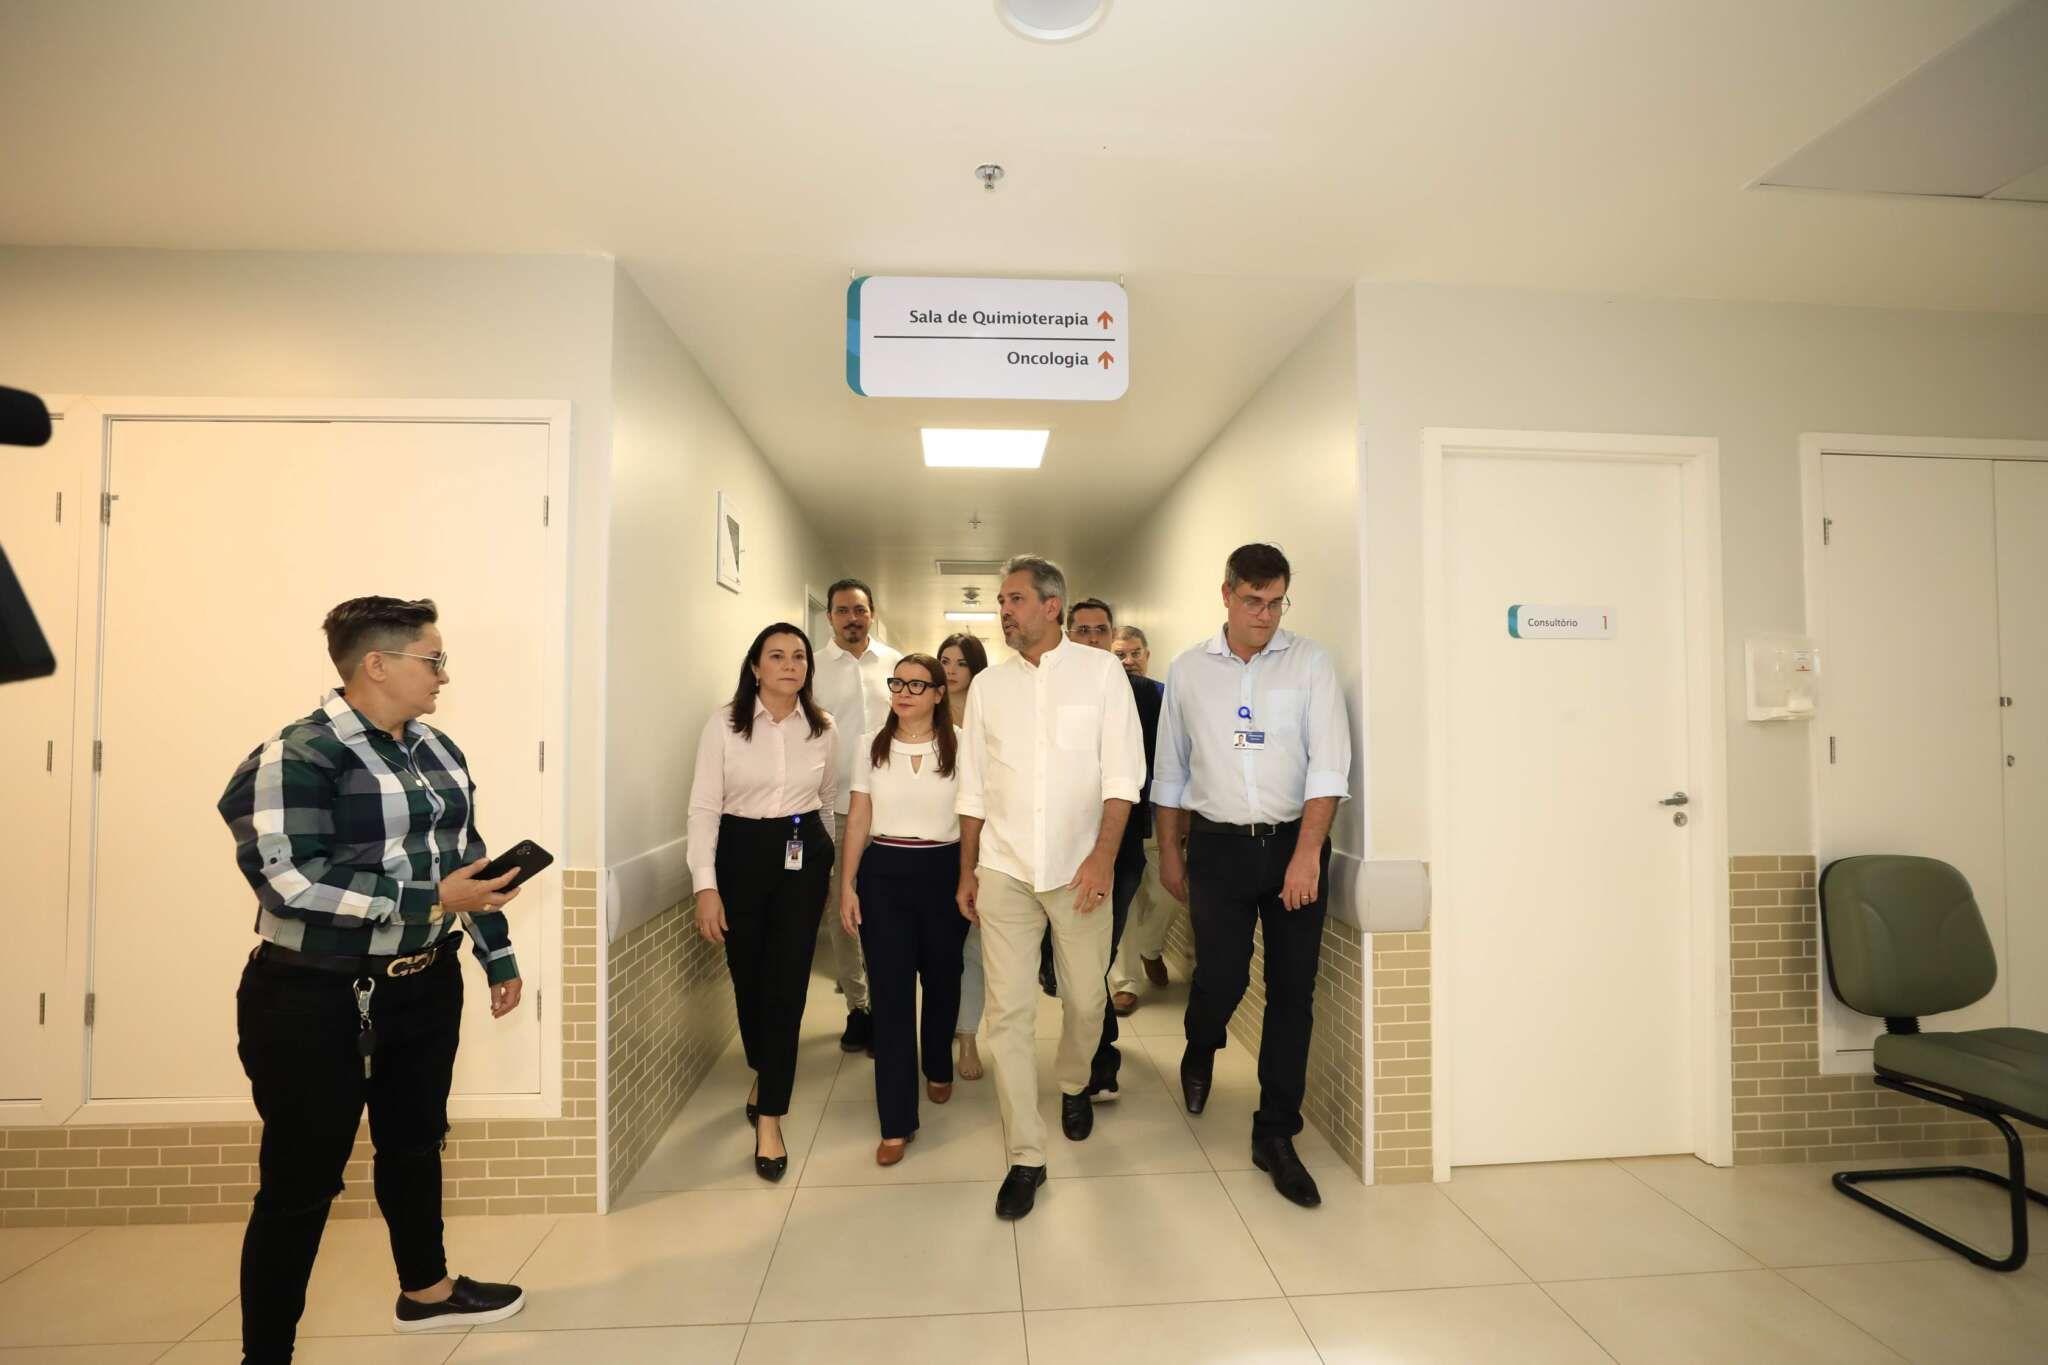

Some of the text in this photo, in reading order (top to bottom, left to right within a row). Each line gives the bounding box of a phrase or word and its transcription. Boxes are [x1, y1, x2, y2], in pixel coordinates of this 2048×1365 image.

[909, 310, 1088, 327] Sala de Quimioterapia
[1007, 351, 1088, 368] Oncologia
[1527, 615, 1608, 630] Consultório 1
